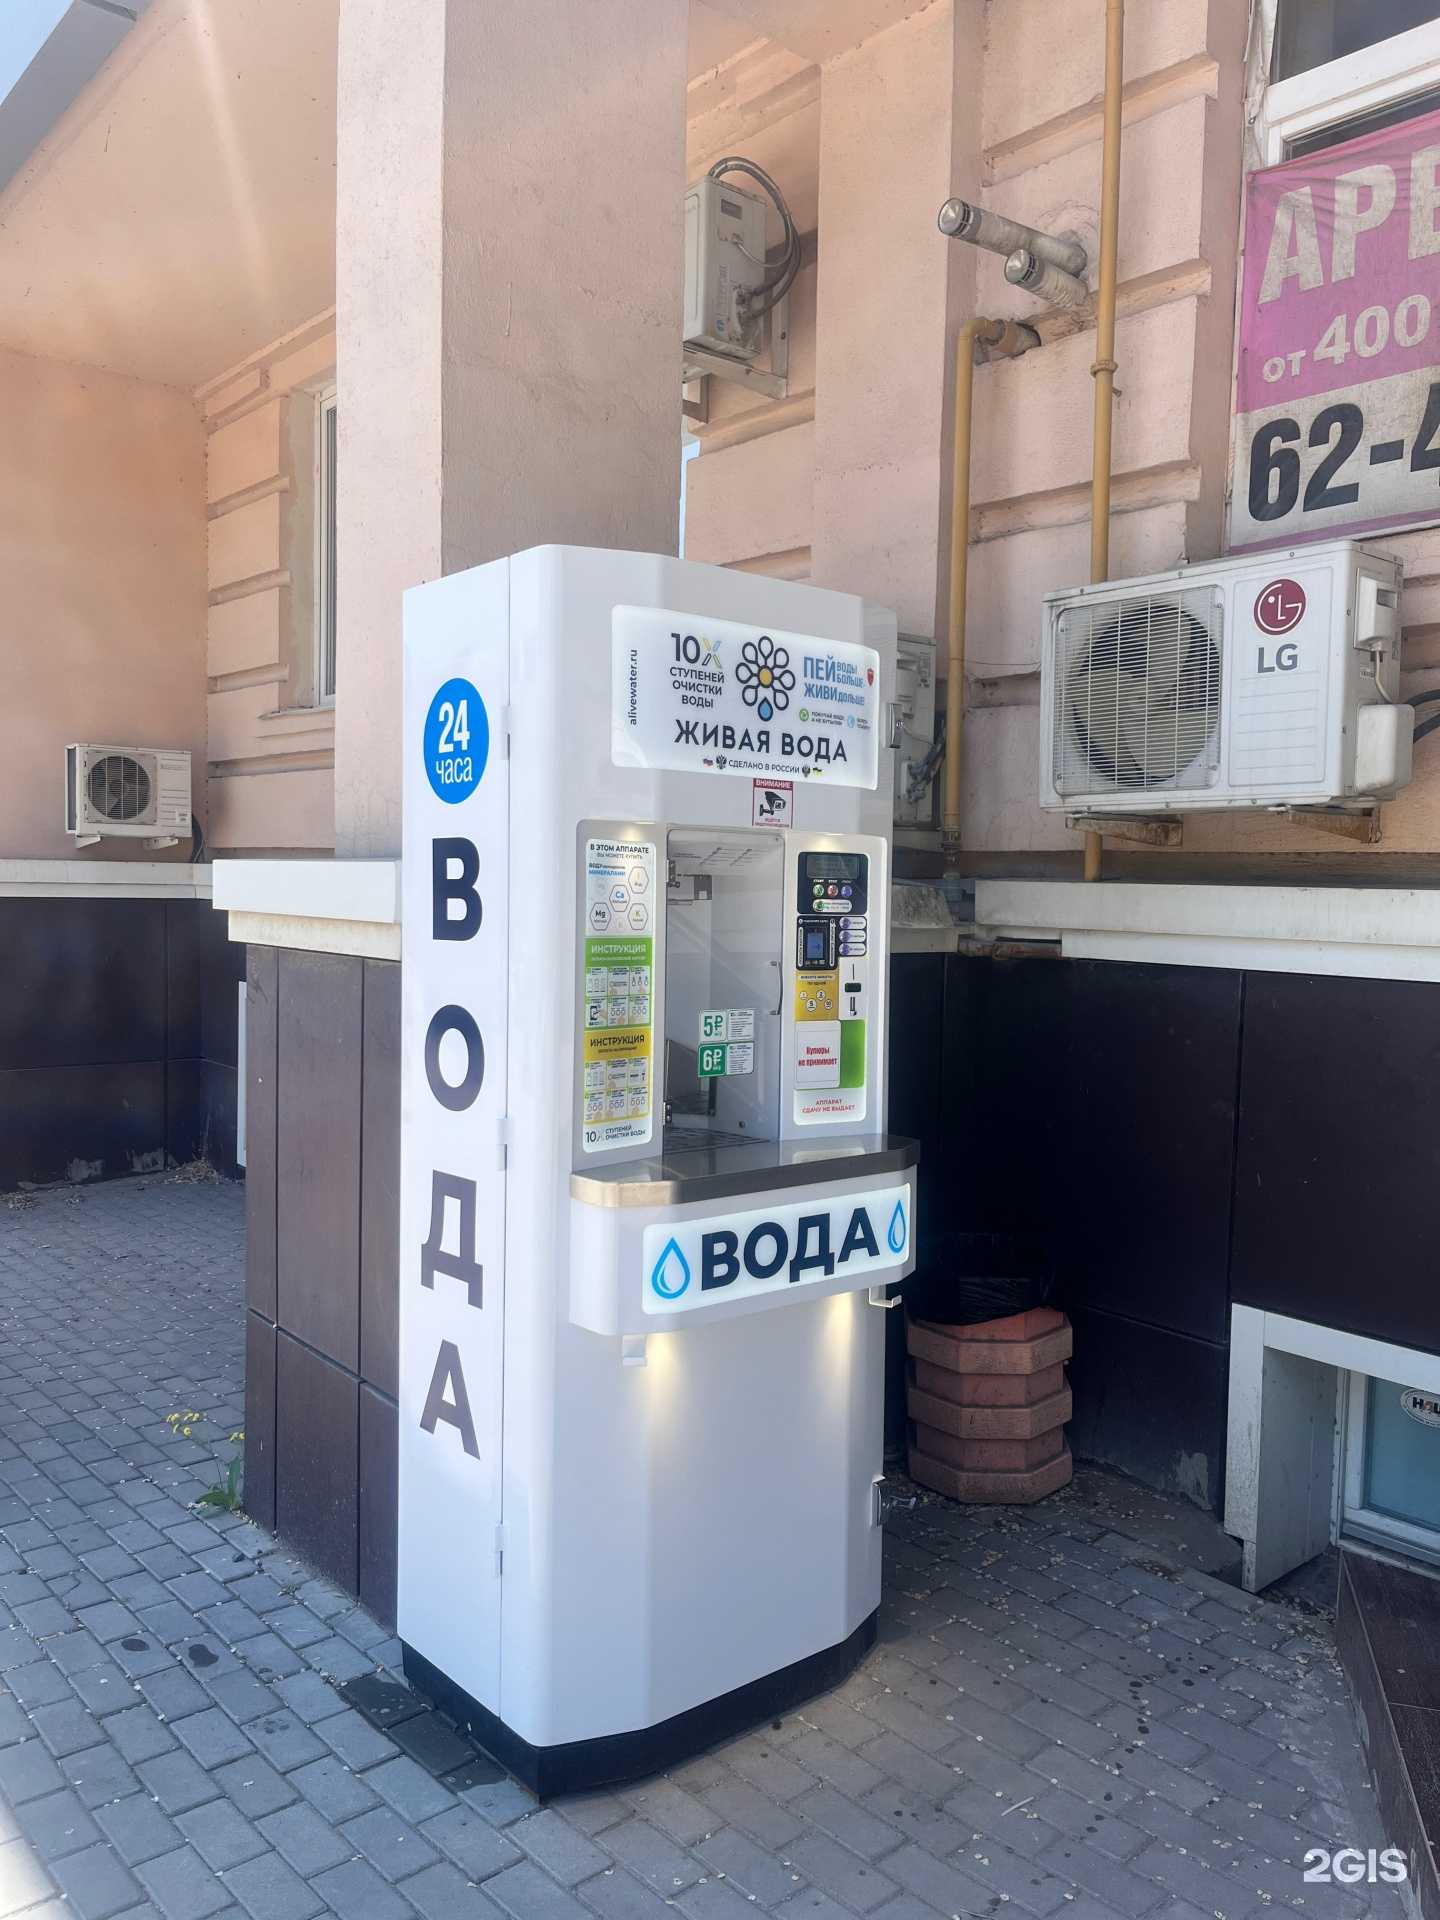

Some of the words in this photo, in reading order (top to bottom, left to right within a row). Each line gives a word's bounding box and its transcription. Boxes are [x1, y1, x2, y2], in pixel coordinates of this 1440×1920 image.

[1312, 294, 1431, 365] 400
[1256, 643, 1298, 674] LG
[669, 666, 725, 683] СТУПЕНЕЙ
[803, 655, 836, 682] ПЕЙ
[628, 649, 638, 726] alivewater.ru
[672, 679, 722, 696] ОЧИСТКИ
[803, 682, 837, 701] ЖИВИ
[681, 694, 714, 709] ВОДЫ
[438, 699, 471, 754] 24
[674, 719, 770, 753] ЖИВАЯ
[781, 732, 848, 764] ВОДА
[436, 756, 473, 784] часа
[728, 759, 763, 770] СДЕЛАНО
[771, 764, 800, 773] РОССИИ
[596, 844, 614, 852] ЭТОМ
[616, 845, 649, 854] АППАРАТЕ
[615, 891, 624, 899] Ca
[595, 910, 606, 919] Mg
[590, 1034, 645, 1047] ИНСТРУКЦИЯ
[701, 1206, 881, 1291] ВОДА
